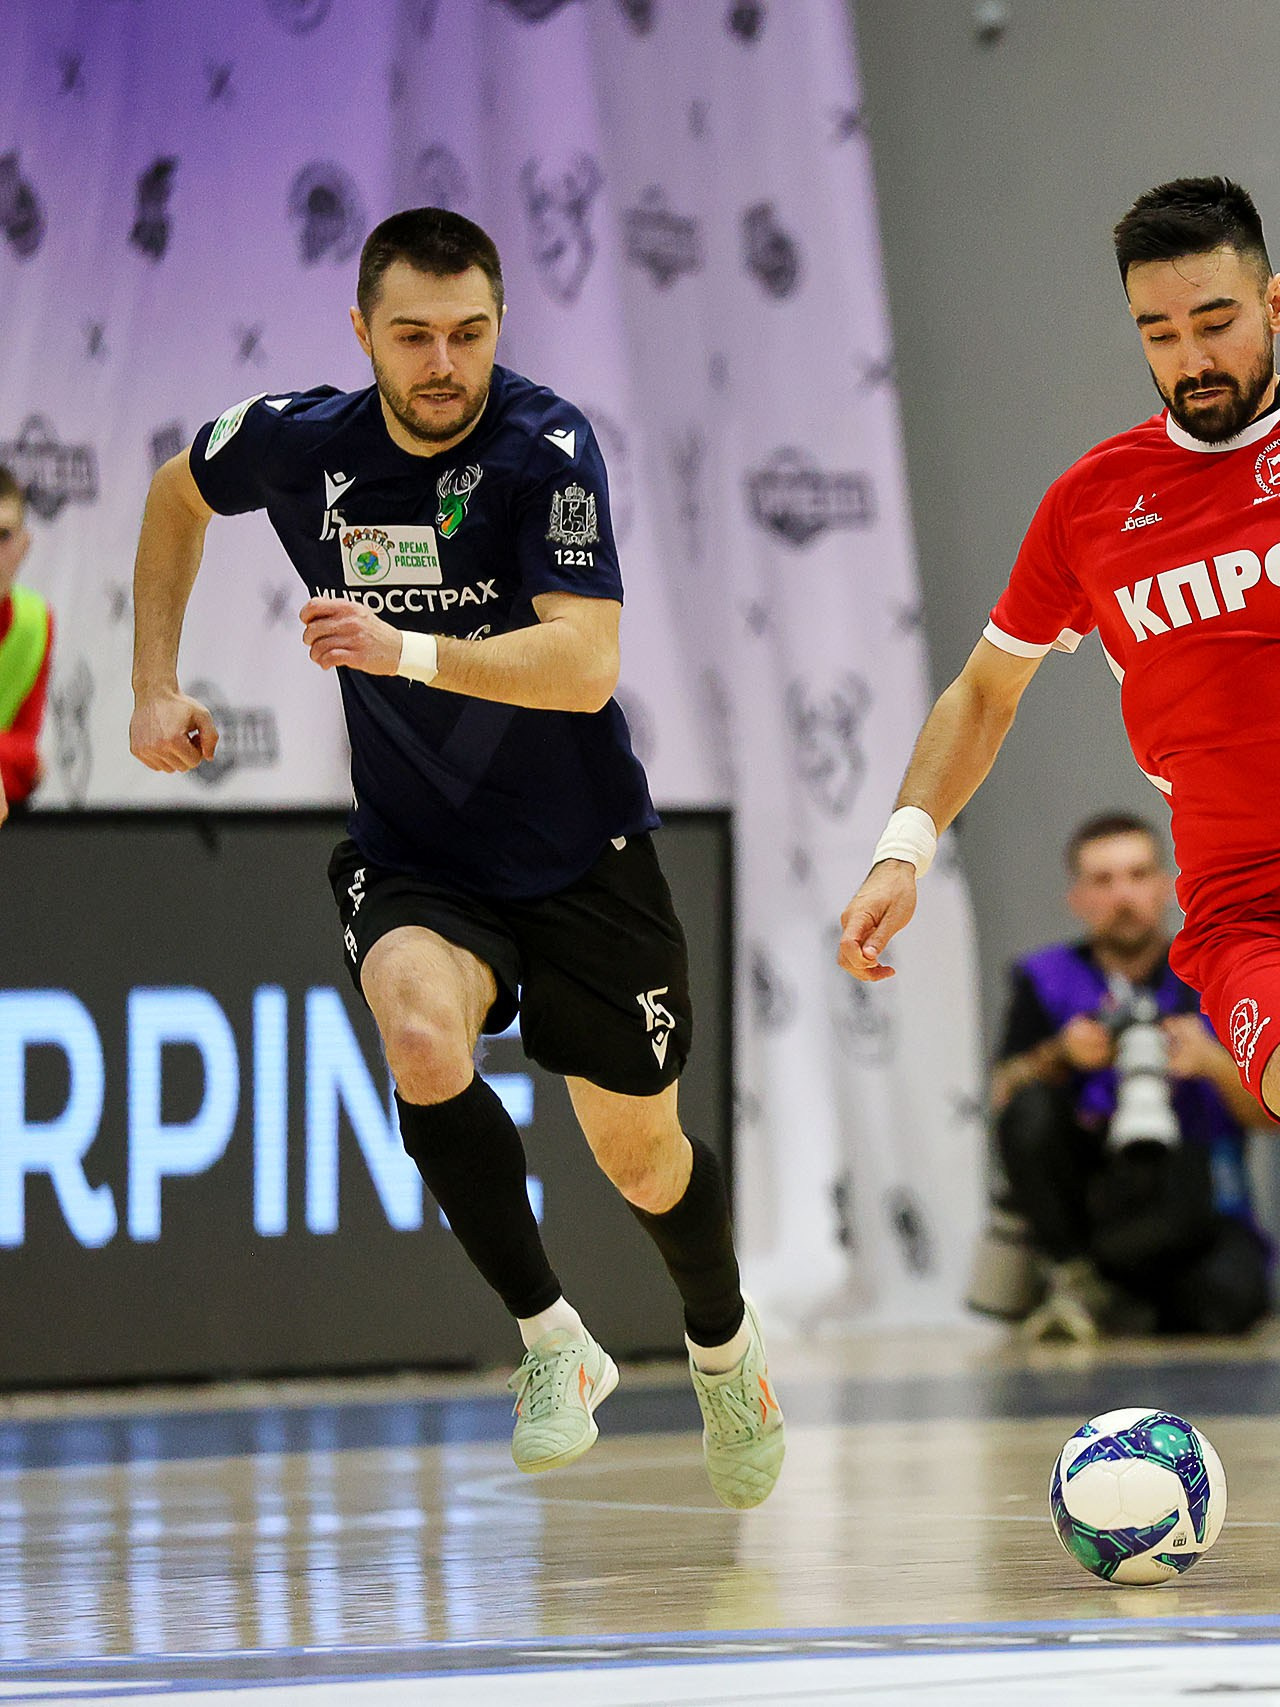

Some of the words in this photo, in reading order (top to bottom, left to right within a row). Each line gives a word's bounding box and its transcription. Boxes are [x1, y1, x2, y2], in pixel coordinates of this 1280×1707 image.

[1120, 512, 1163, 532] JÖGEL
[399, 541, 430, 554] ВРЕМЯ
[394, 555, 438, 568] РАССВЕТА
[554, 549, 594, 567] 1221
[636, 986, 676, 1032] 15
